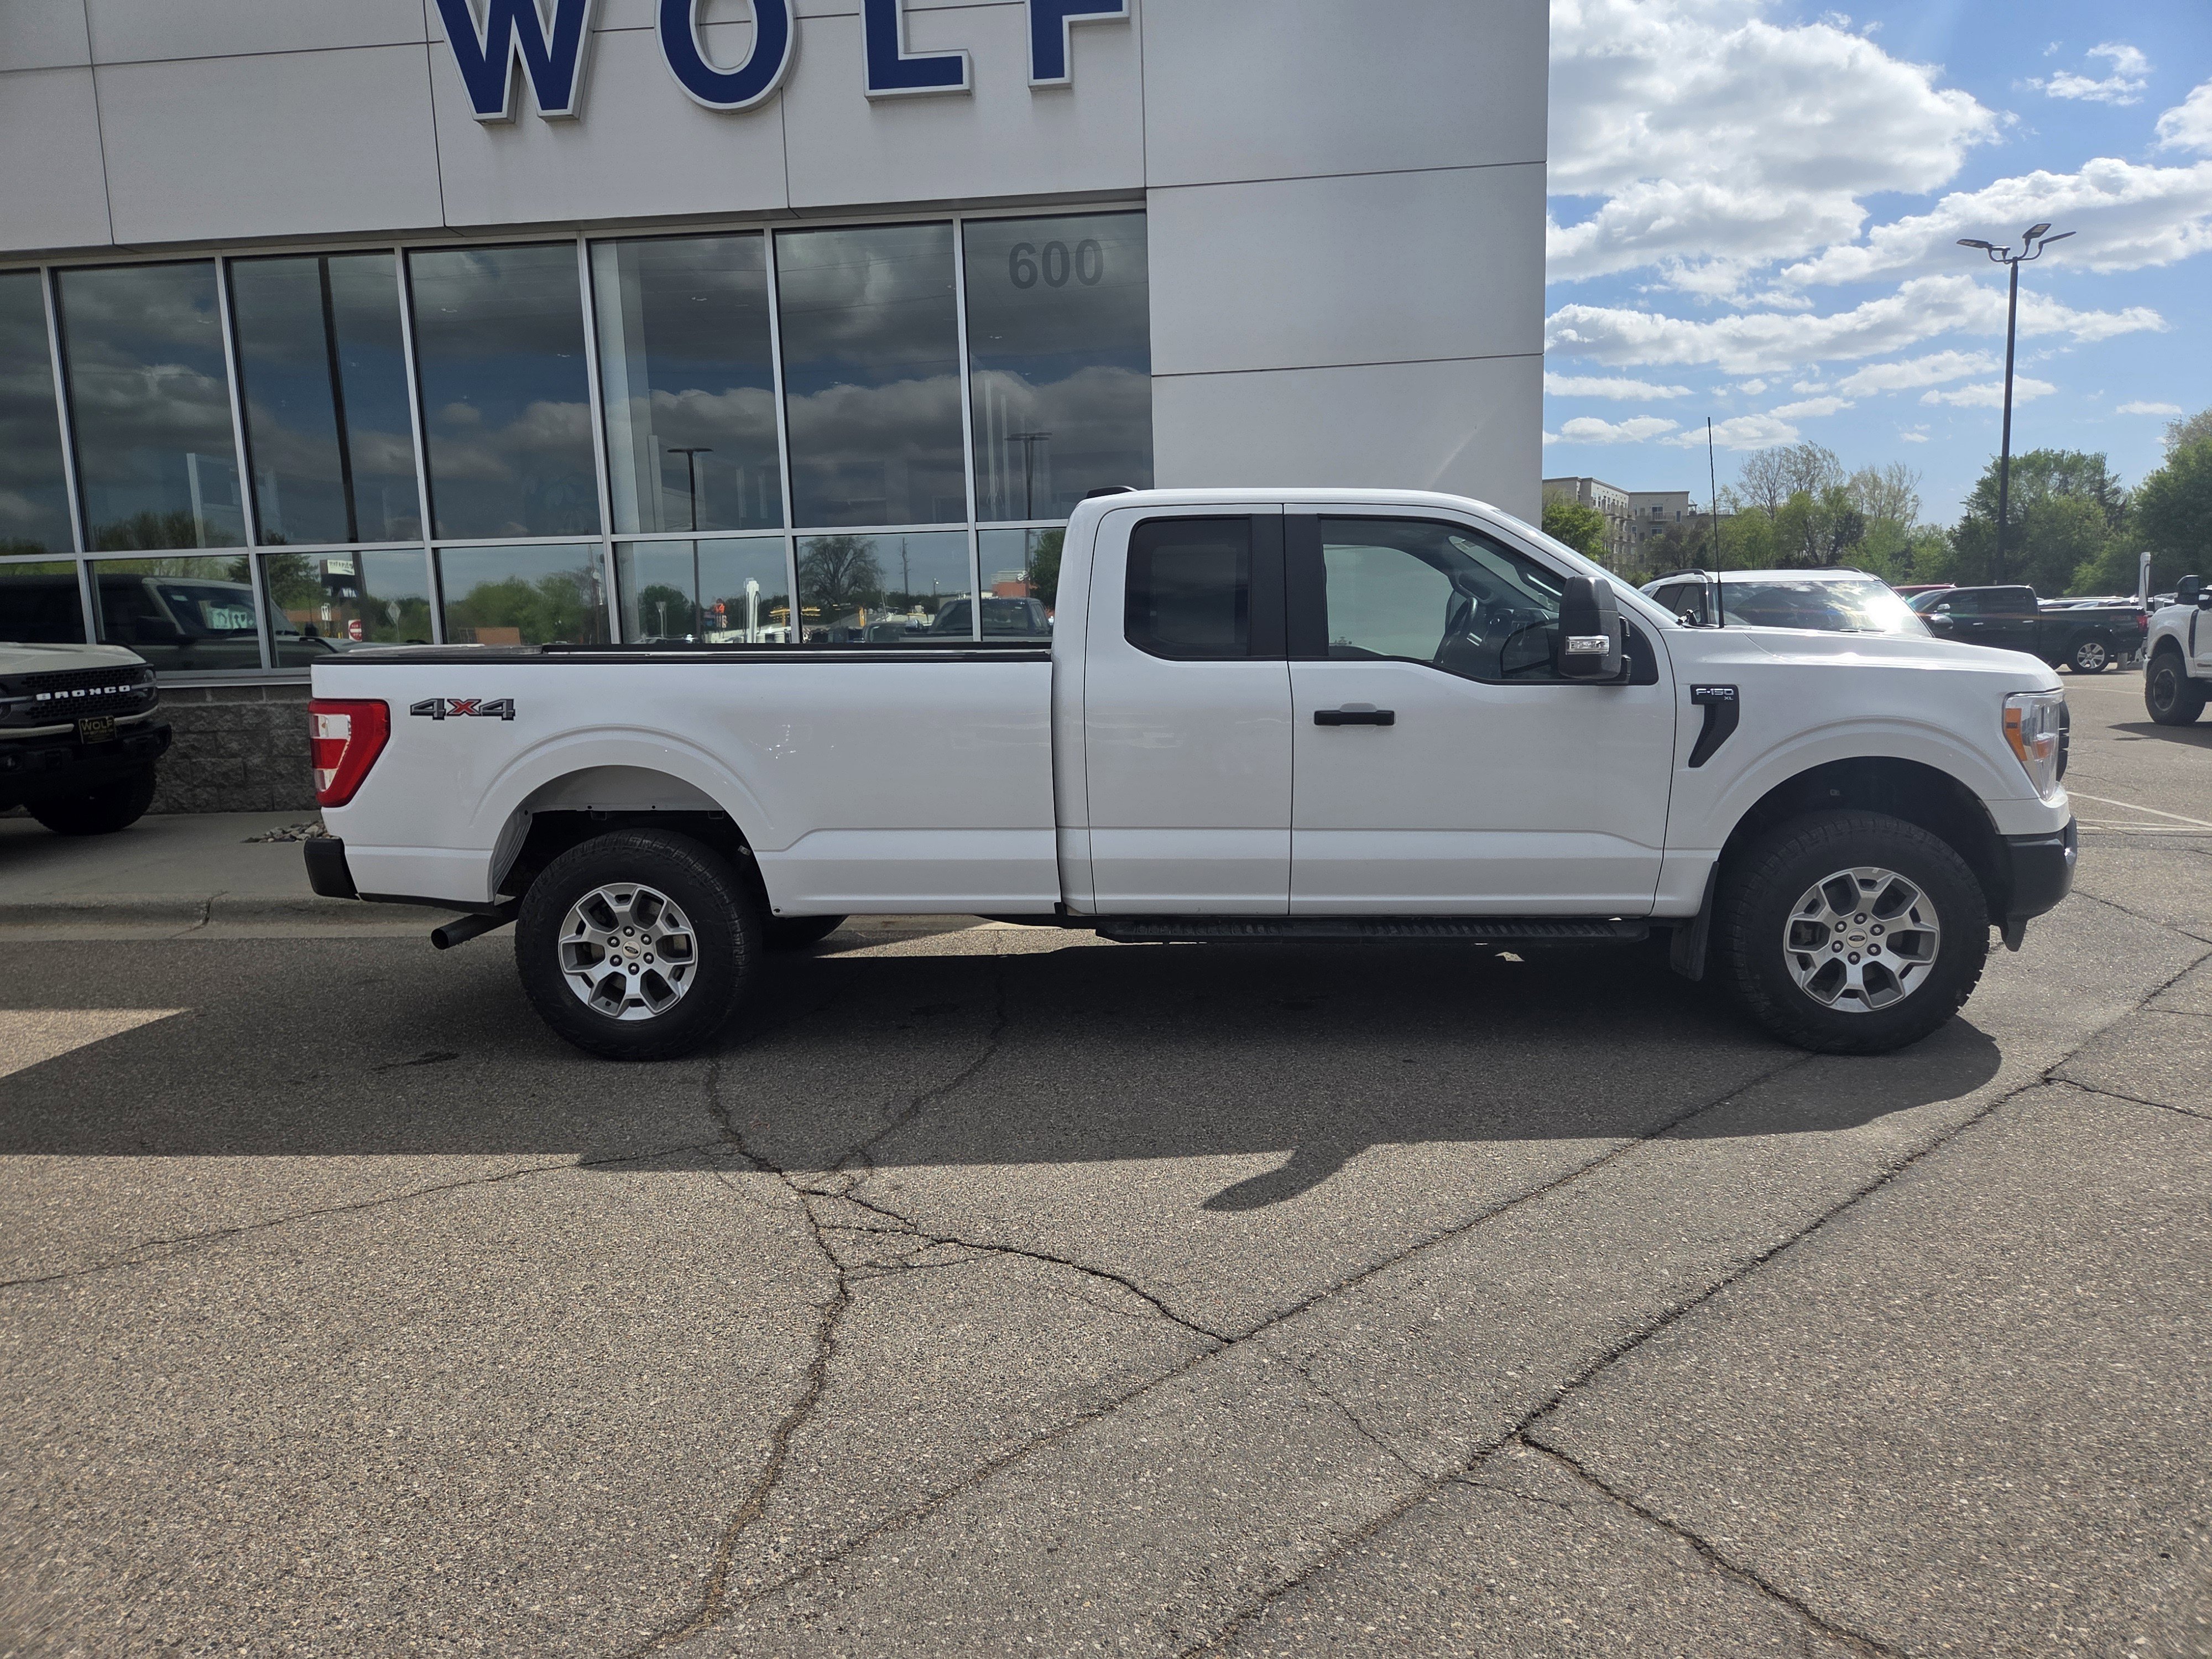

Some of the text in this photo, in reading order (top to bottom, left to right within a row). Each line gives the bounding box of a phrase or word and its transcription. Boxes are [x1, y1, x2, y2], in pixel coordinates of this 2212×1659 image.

[1009, 238, 1104, 289] 600
[36, 685, 131, 701] BRONCO
[81, 719, 113, 731] WOLF
